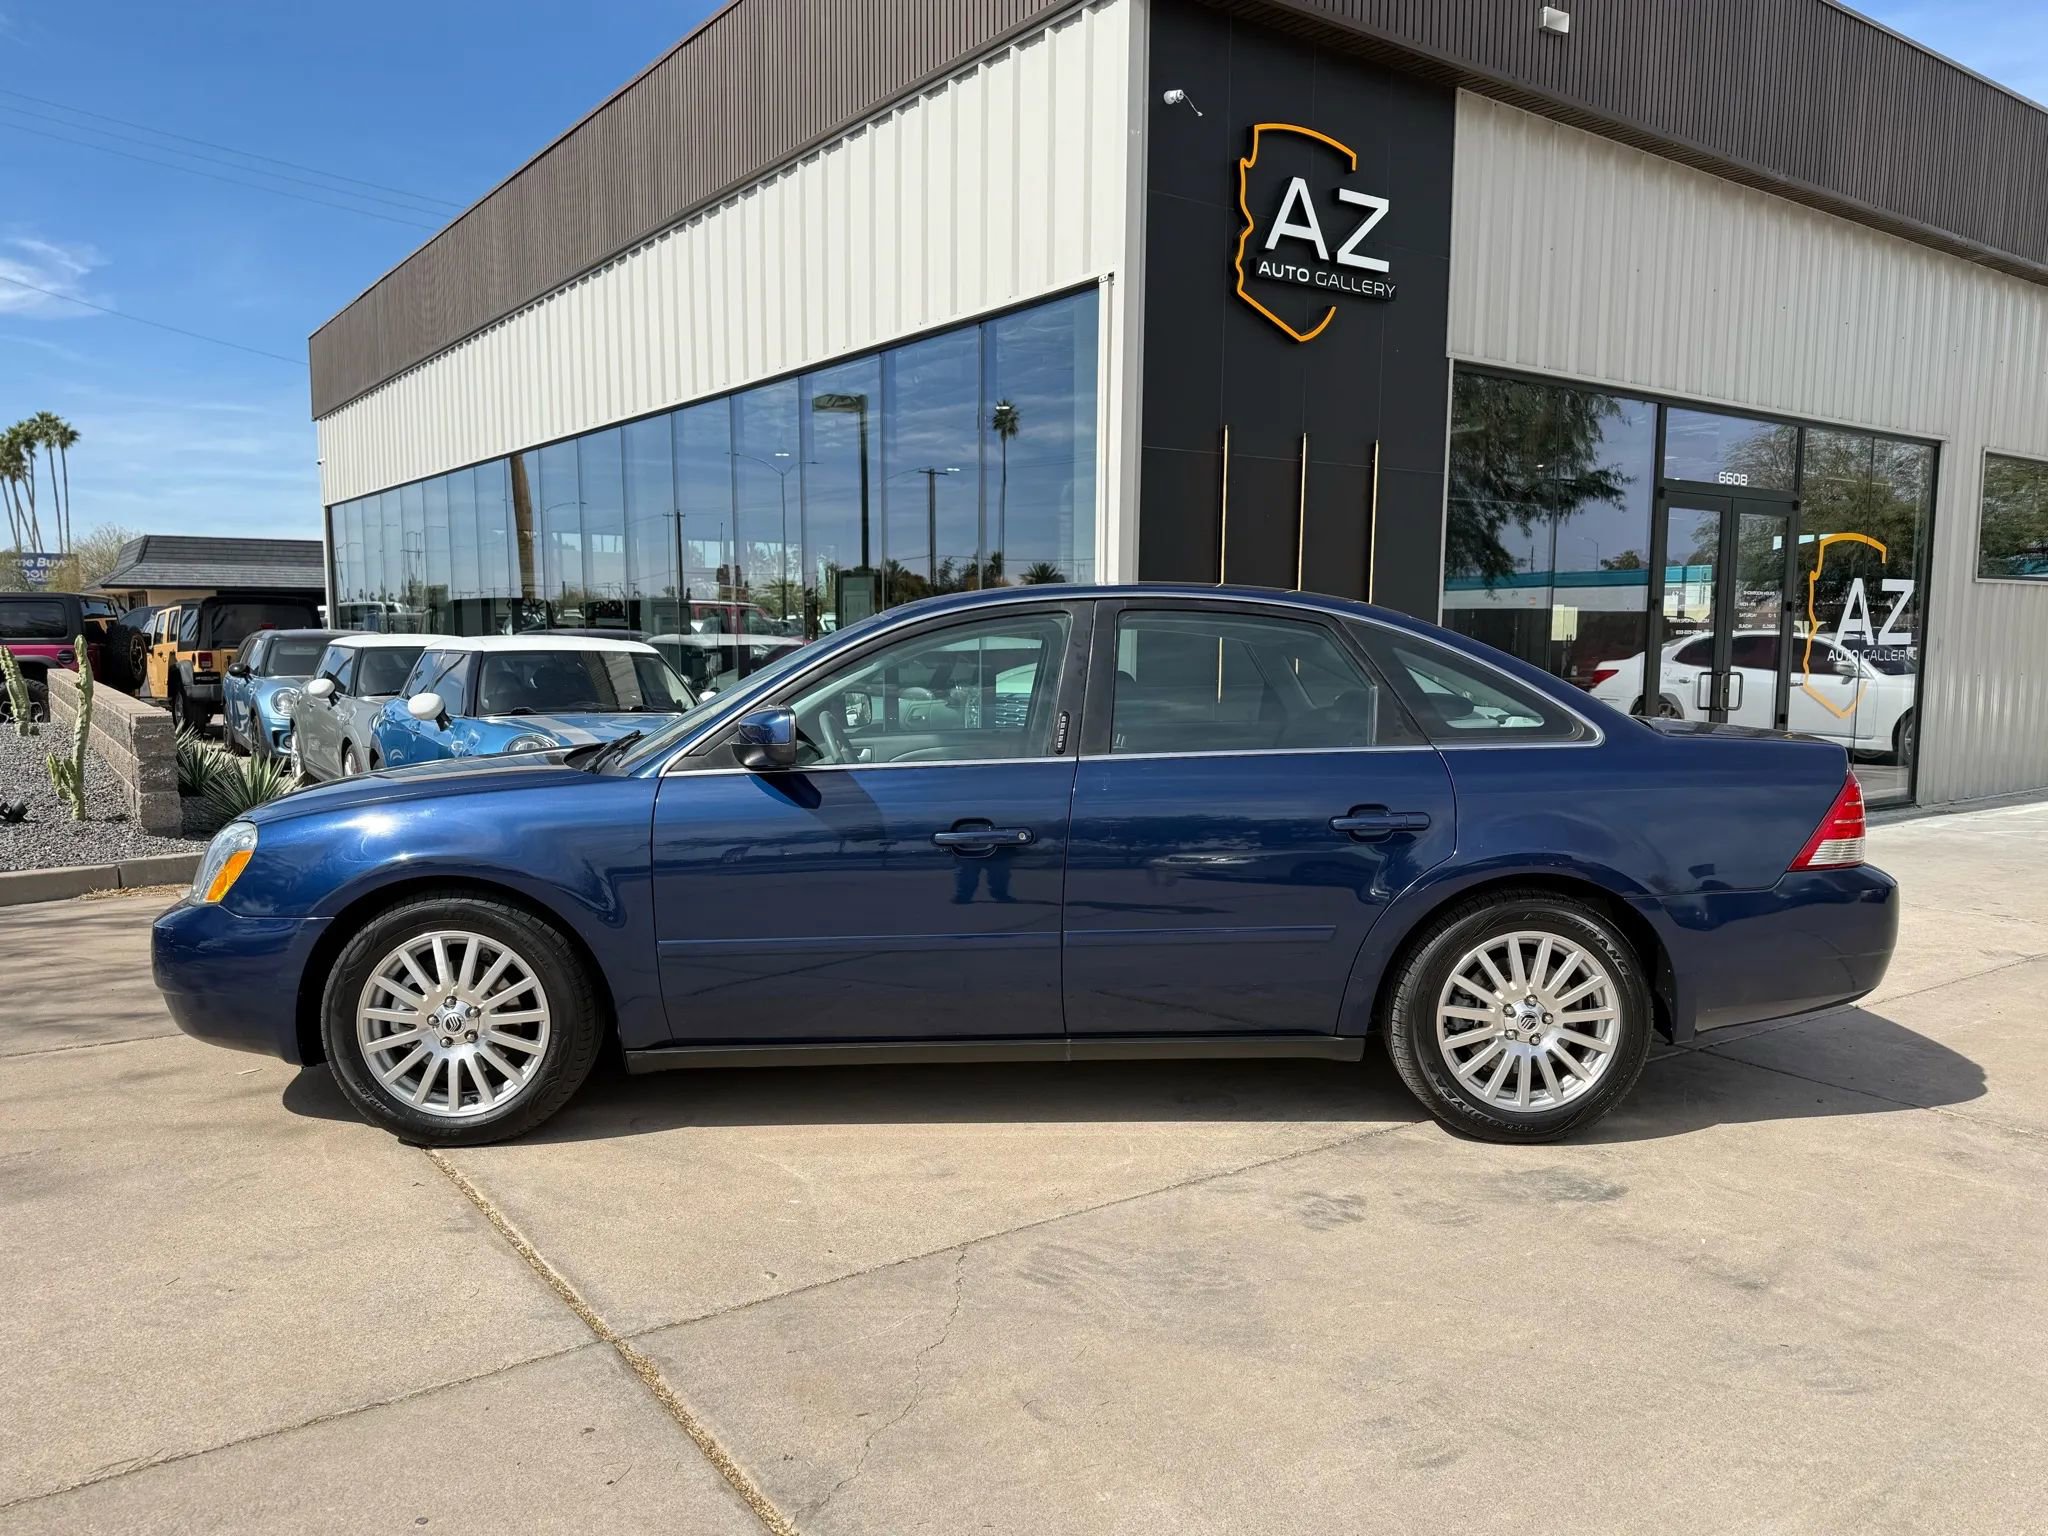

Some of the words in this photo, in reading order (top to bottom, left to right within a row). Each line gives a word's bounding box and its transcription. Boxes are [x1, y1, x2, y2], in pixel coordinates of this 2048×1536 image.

[1264, 176, 1389, 272] AZ
[1258, 261, 1310, 282] AUTO
[1315, 271, 1396, 298] GALLERY
[1718, 471, 1748, 486] 6608
[1834, 577, 1915, 645] AZ
[1827, 649, 1859, 661] AUTO
[1862, 649, 1914, 662] GALLERY
